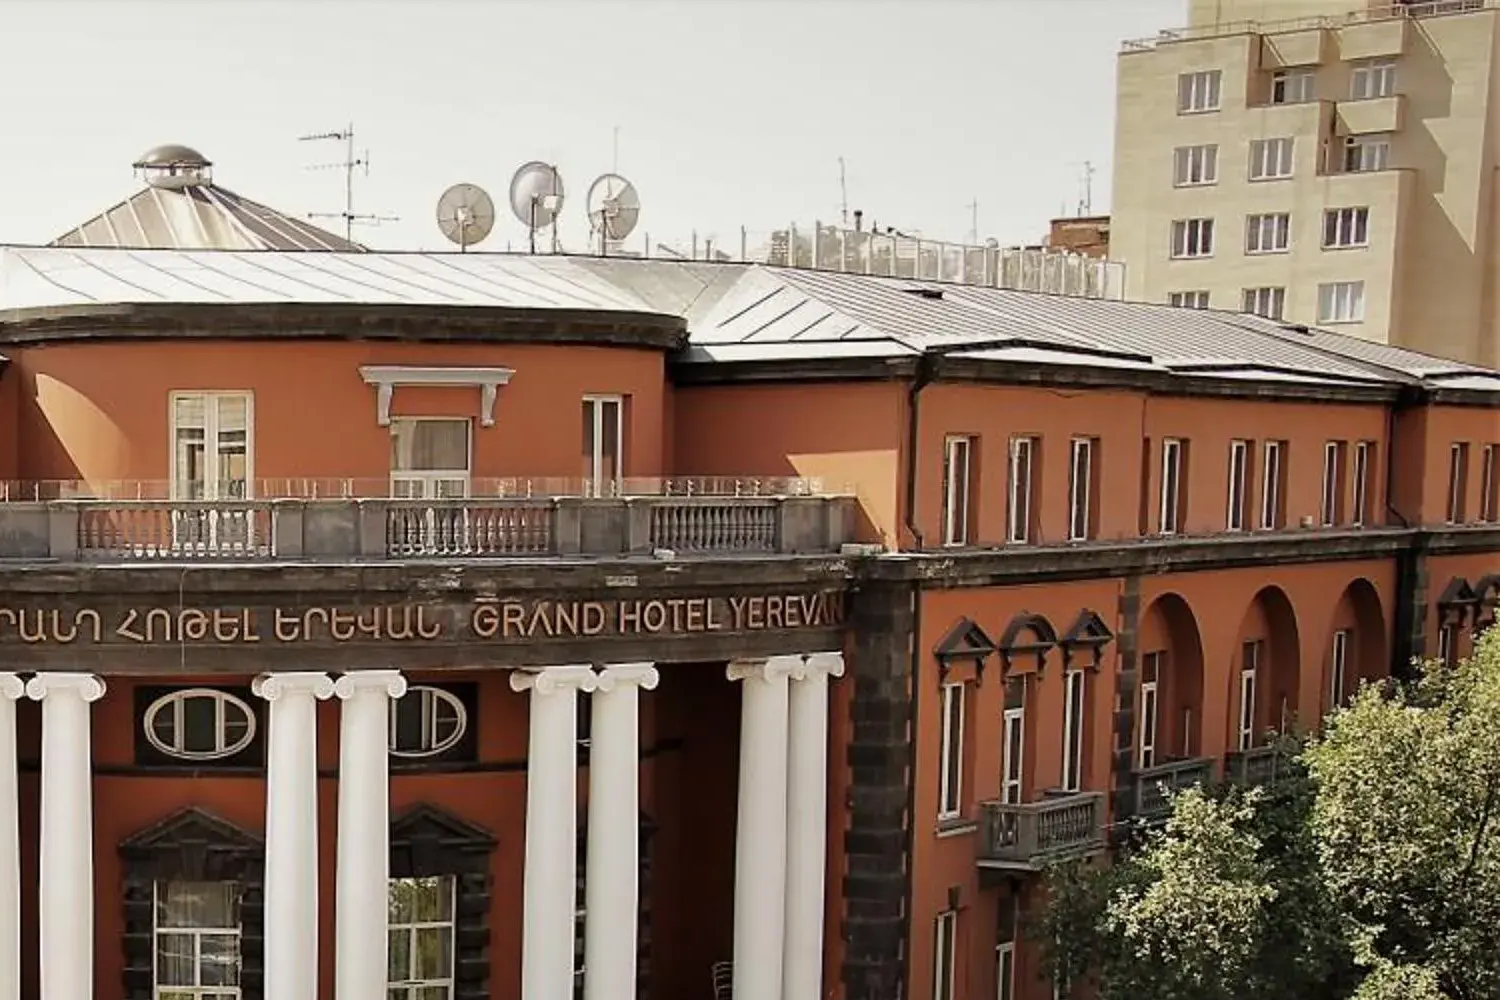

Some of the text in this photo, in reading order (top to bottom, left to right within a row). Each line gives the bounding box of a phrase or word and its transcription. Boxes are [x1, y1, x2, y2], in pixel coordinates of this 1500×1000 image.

[115, 607, 260, 642] ՀՈԹԵԼ
[274, 605, 441, 641] ԵՐԵՎԱՆ
[472, 591, 845, 637] GRAND HOTEL YEREVAN
